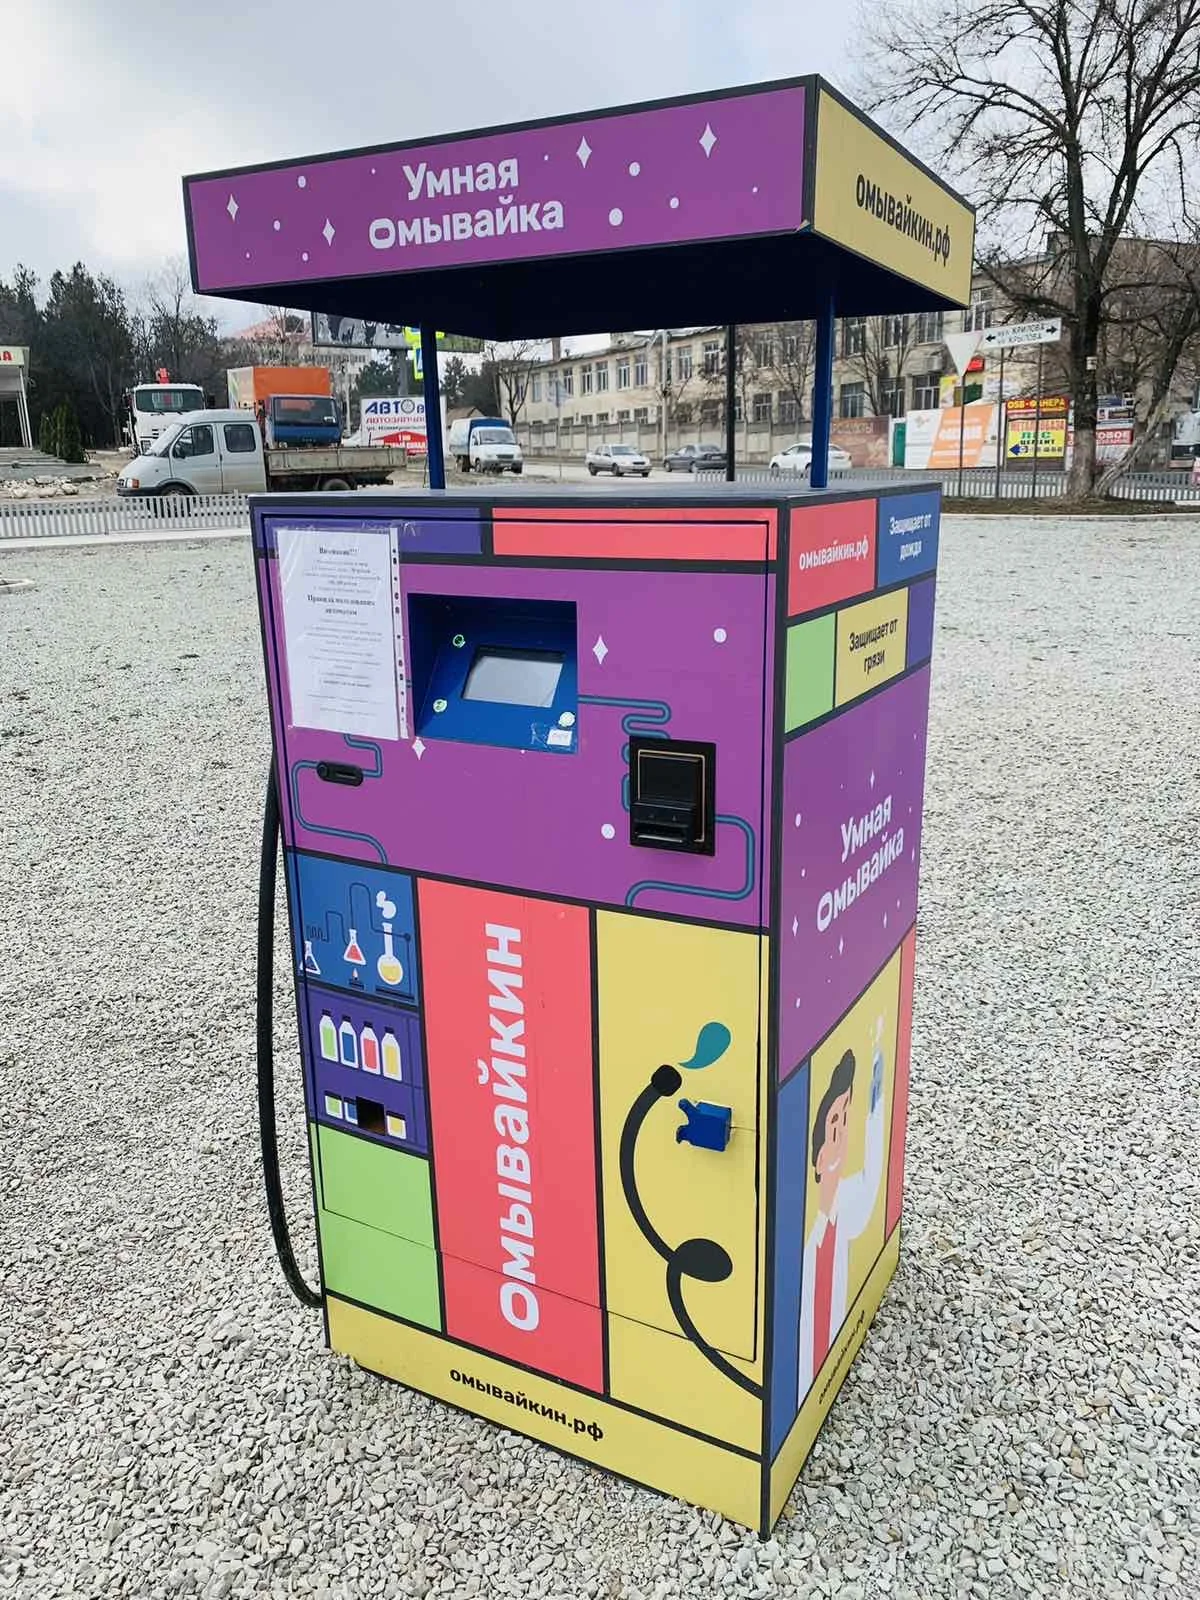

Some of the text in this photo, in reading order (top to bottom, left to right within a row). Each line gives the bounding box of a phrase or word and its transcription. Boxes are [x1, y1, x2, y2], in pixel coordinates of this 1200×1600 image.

[402, 157, 519, 201] Умная
[368, 194, 565, 249] Омывайка
[856, 173, 951, 268] омывайкин.рф
[889, 513, 932, 536] Защищает от
[799, 535, 870, 570] омывайкин.рф
[849, 618, 899, 652] Защищает от
[863, 650, 885, 675] грязи
[840, 794, 893, 863] Умная
[816, 827, 904, 932] Омывайка
[477, 922, 540, 1332] Омывайкин
[449, 1368, 605, 1442] омывайкин.рф
